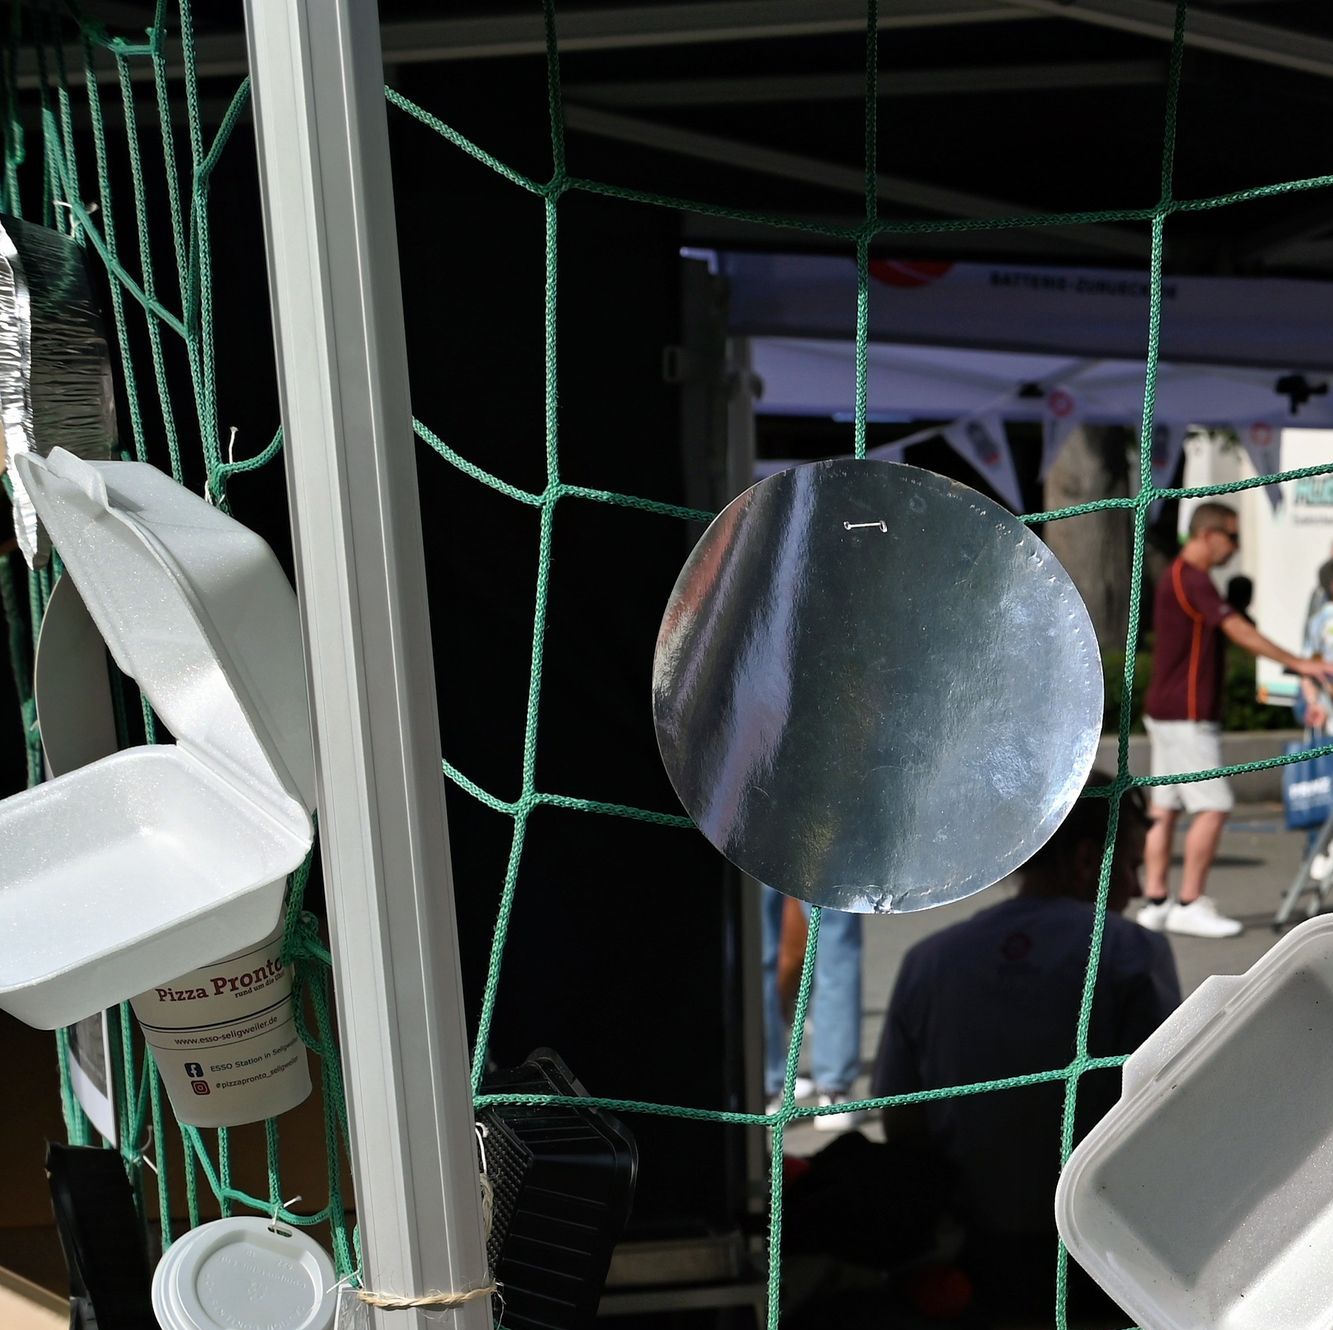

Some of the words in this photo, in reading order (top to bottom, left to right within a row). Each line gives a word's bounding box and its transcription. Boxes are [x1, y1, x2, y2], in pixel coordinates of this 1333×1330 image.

[155, 987, 209, 1002] Pizza
[234, 986, 253, 999] rund
[253, 983, 265, 992] um
[174, 1015, 278, 1046] www.esso-seligweiler.de
[210, 1063, 233, 1073] ESSO
[235, 1056, 263, 1068] Station
